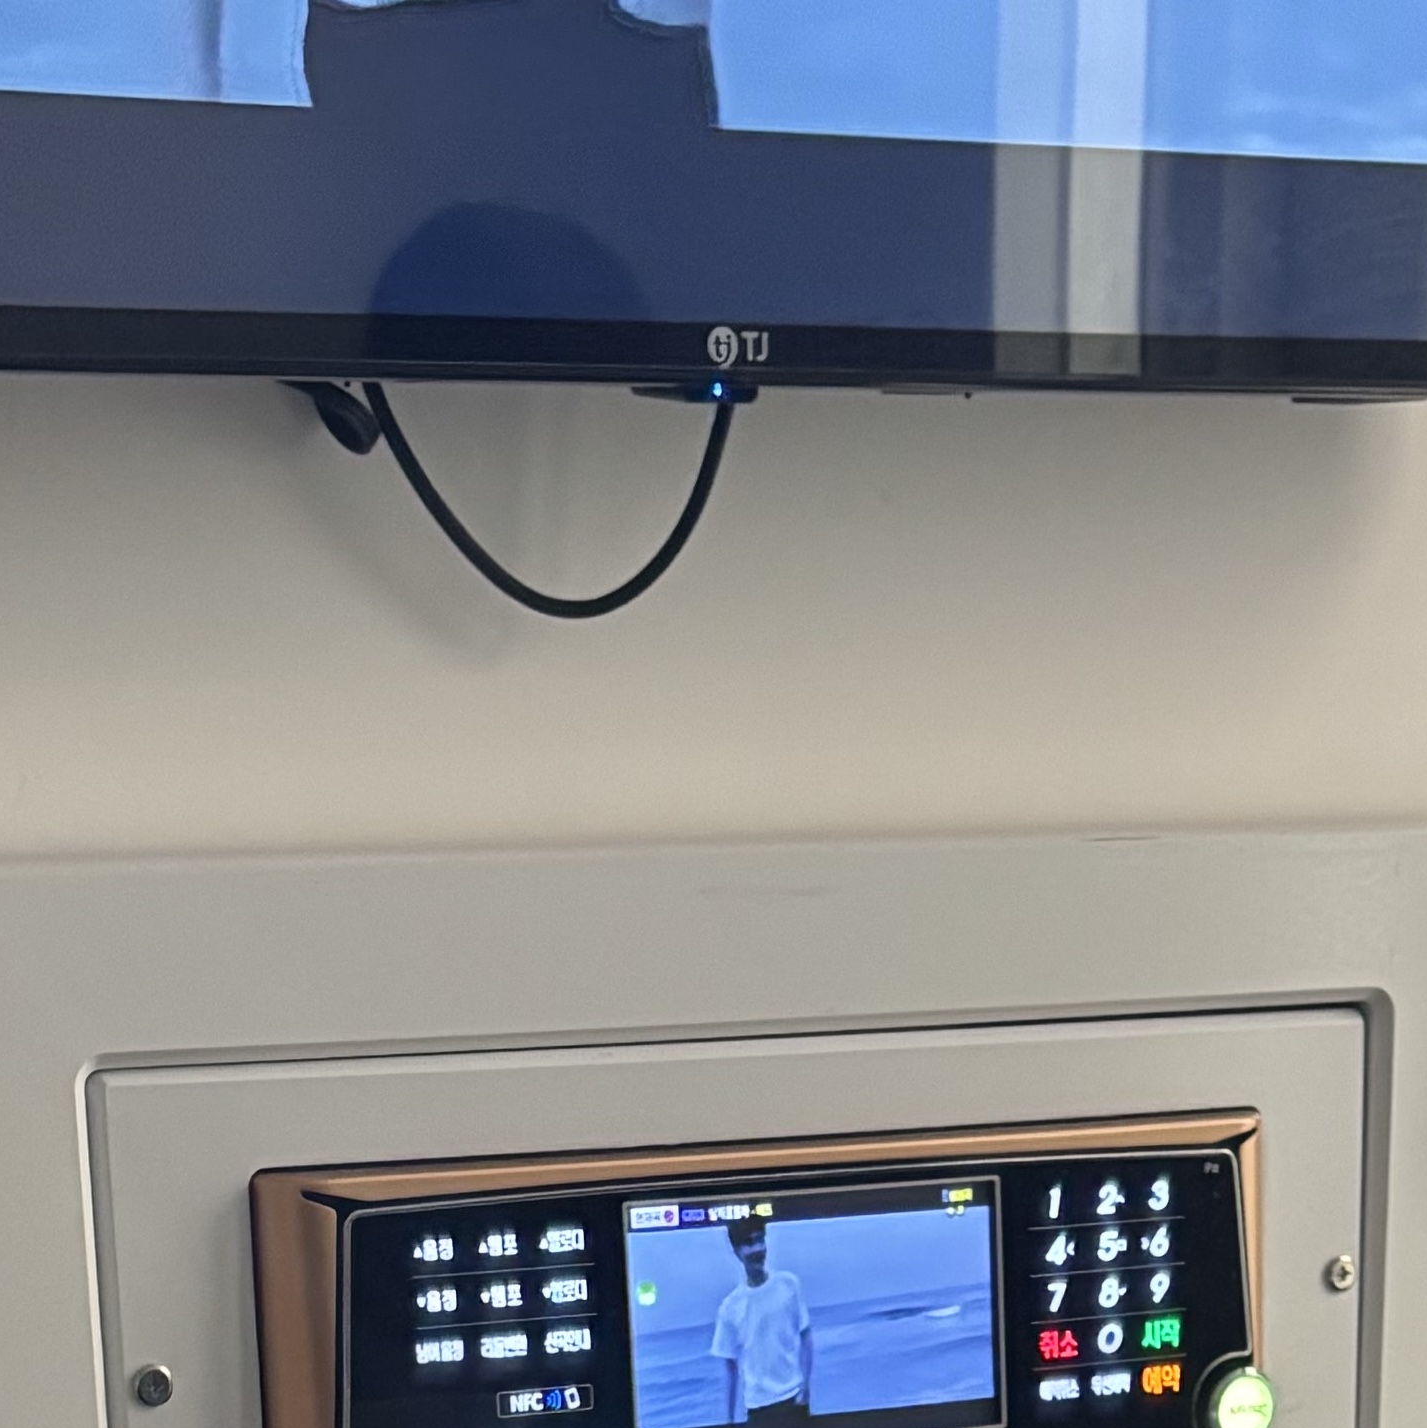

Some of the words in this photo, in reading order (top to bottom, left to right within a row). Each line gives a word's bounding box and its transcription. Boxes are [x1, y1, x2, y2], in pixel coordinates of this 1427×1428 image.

[740, 331, 769, 362] TJ
[1049, 1186, 1062, 1219] 1
[1096, 1184, 1118, 1216] 2
[1147, 1179, 1170, 1211] 3
[1045, 1233, 1067, 1266] 4
[1097, 1230, 1119, 1262] 5
[1149, 1225, 1170, 1257] 6
[1047, 1281, 1067, 1313] 7
[1098, 1277, 1120, 1308] 8
[1149, 1272, 1170, 1304] 9
[1038, 1329, 1079, 1360] 취소
[1097, 1322, 1124, 1355] 0
[1141, 1318, 1181, 1349] 시작
[1141, 1363, 1181, 1395] 예약
[509, 1392, 544, 1413] NFC
